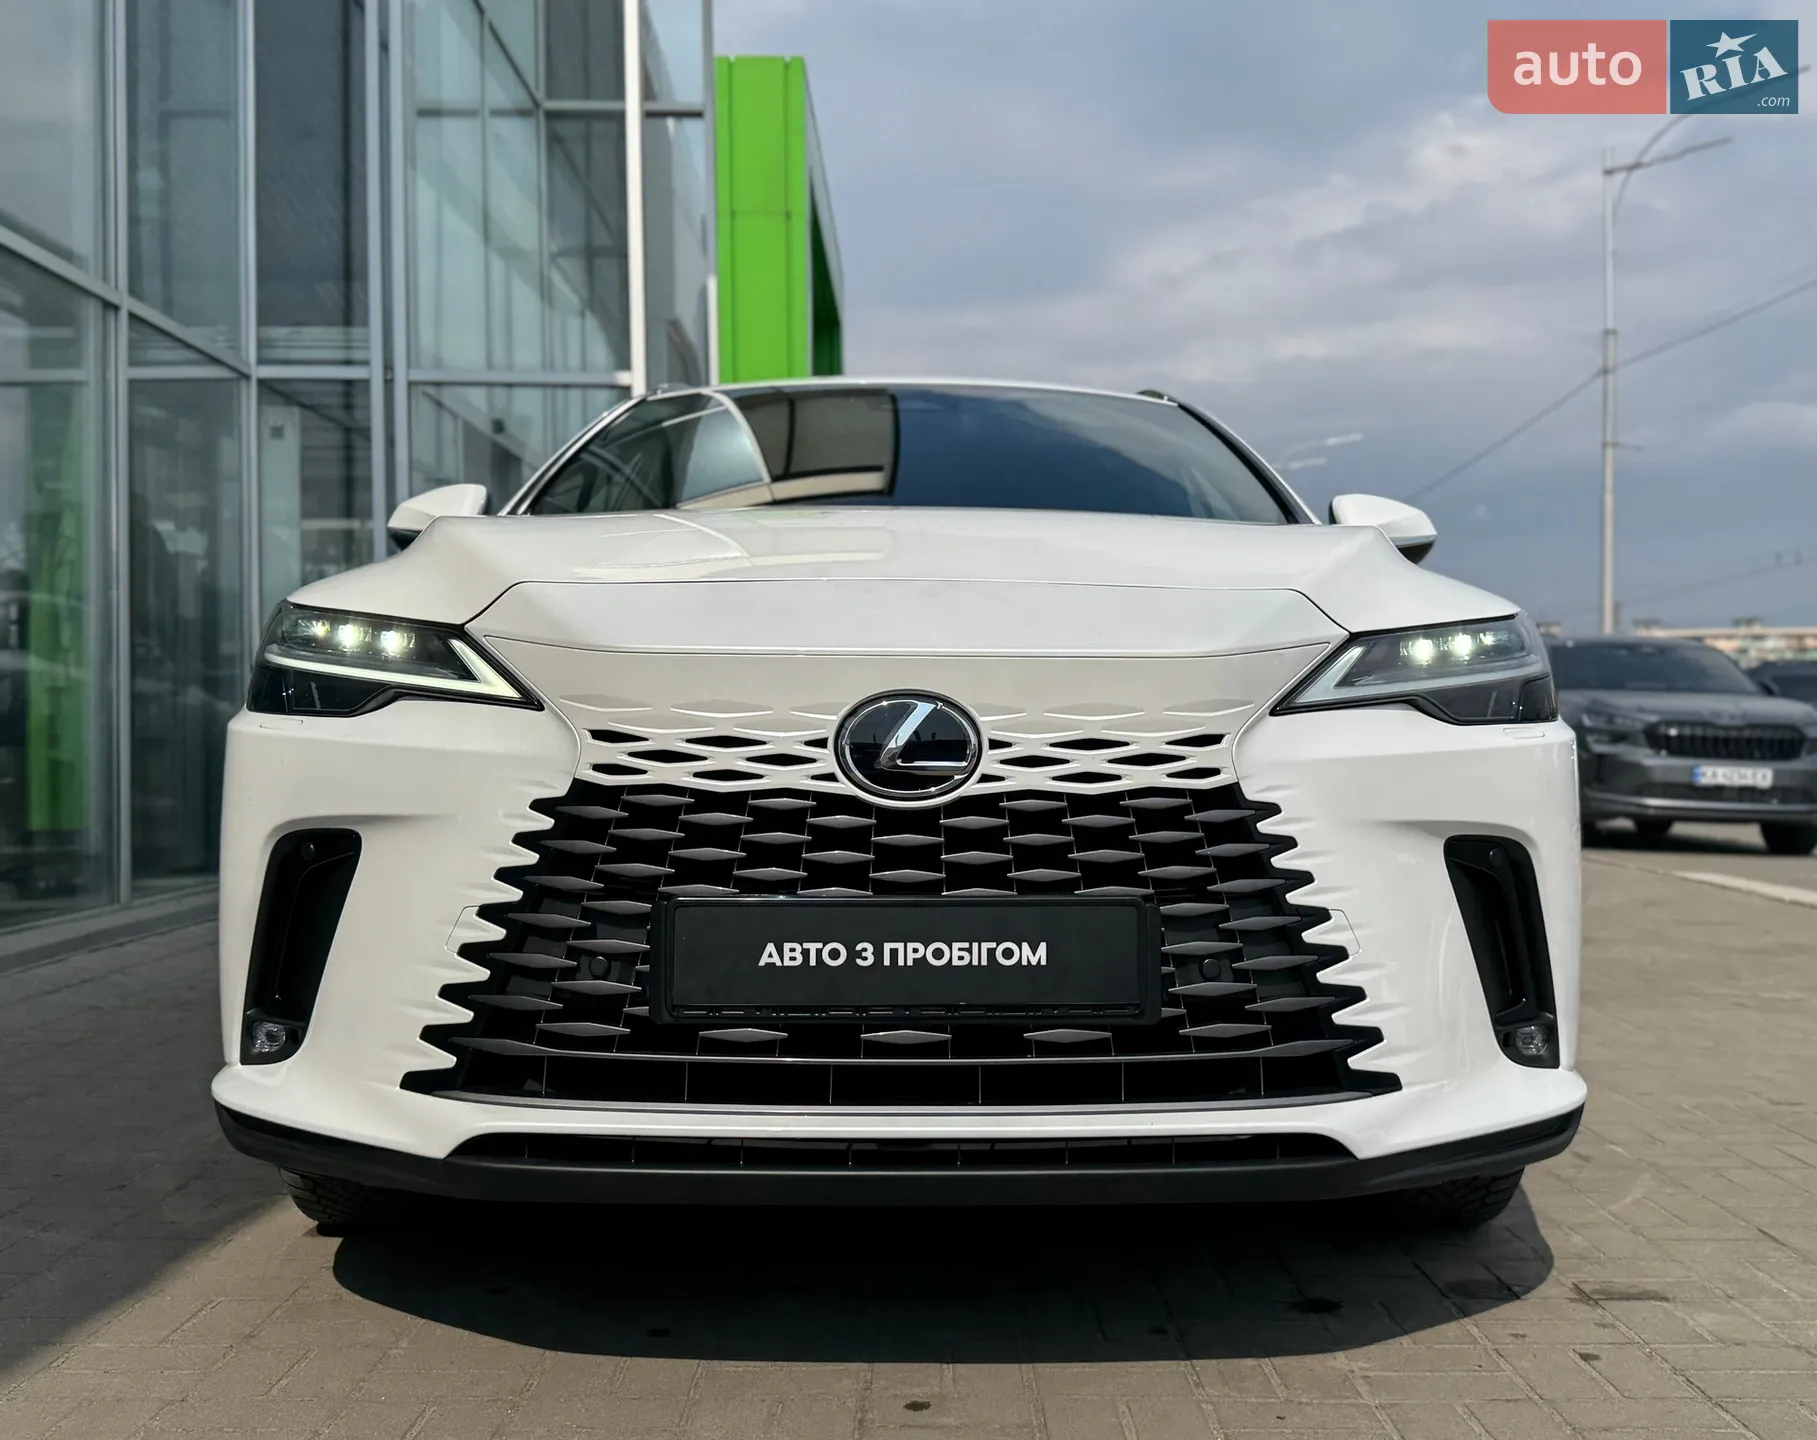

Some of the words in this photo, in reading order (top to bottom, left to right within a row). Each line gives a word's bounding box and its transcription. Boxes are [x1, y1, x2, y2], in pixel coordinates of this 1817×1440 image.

[757, 941, 848, 967] АВТО
[855, 941, 875, 967] З
[883, 941, 1047, 967] ПРОБІГОМ
